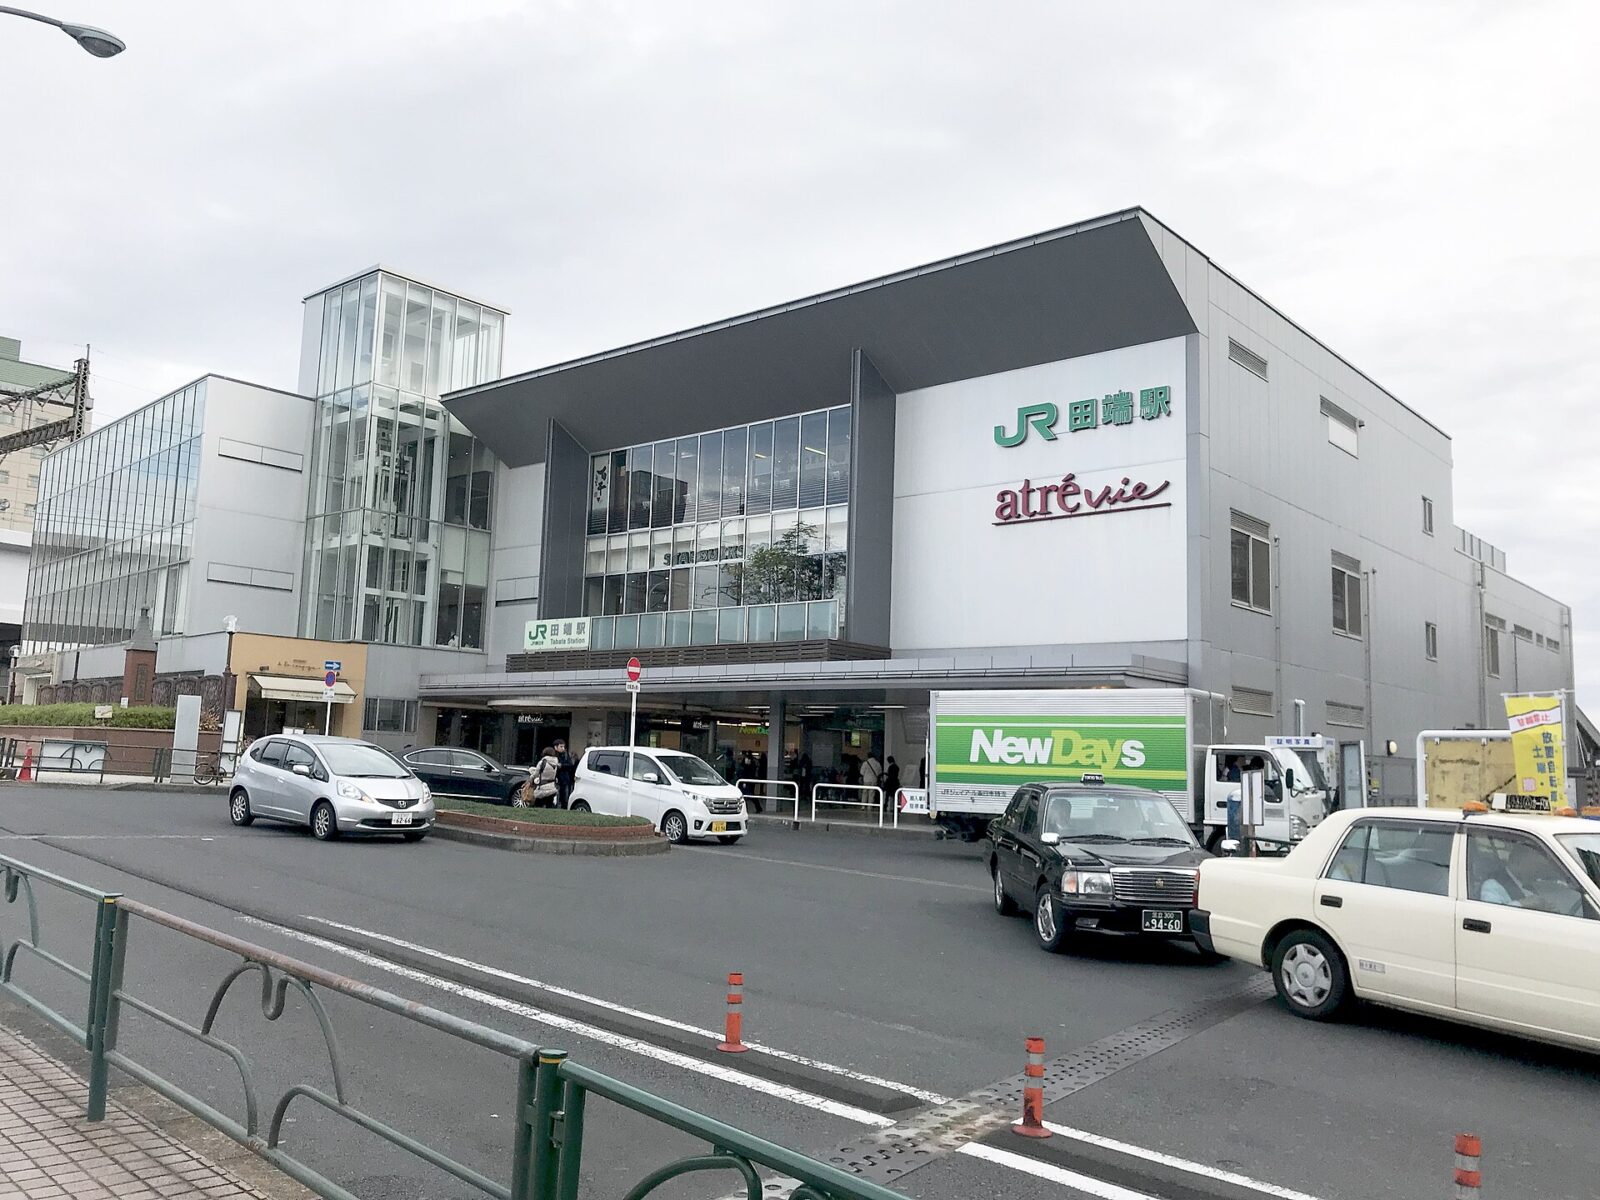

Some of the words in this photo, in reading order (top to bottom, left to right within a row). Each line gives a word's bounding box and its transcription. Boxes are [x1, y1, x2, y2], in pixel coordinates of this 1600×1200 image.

[994, 402, 1058, 447] JR
[1068, 385, 1171, 433] 田端駅
[528, 624, 547, 640] JR
[550, 621, 586, 637] 田端駅
[567, 637, 586, 645] Station
[969, 728, 1146, 772] NewDays
